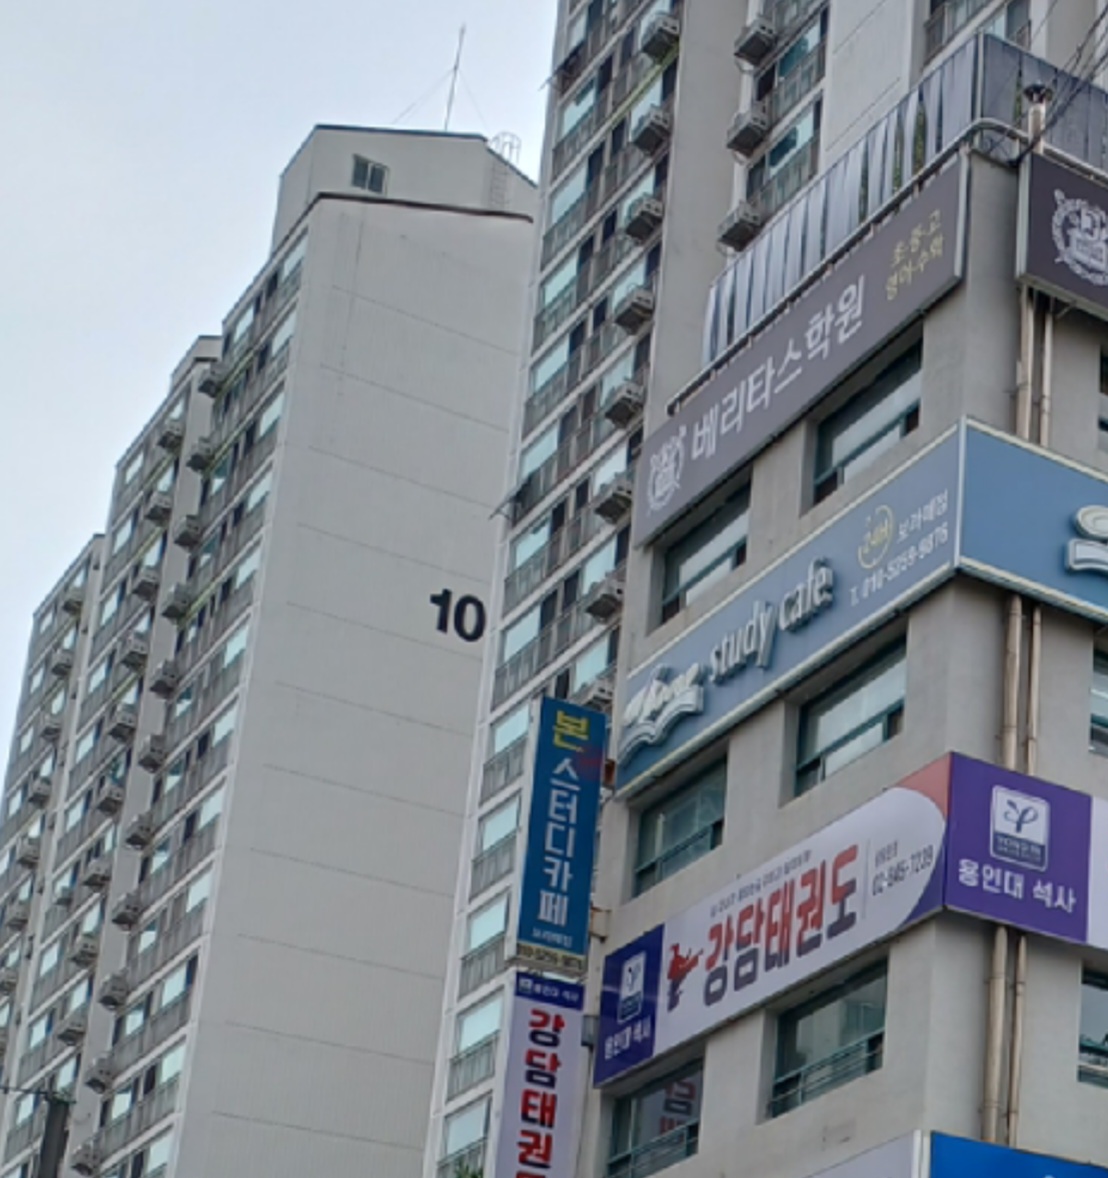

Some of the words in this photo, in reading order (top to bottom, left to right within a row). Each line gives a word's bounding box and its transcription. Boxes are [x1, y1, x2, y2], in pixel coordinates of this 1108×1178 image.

[691, 275, 864, 460] 베리타스학원
[430, 588, 486, 642] 10
[709, 600, 777, 684] study
[778, 556, 836, 632] cafe
[553, 710, 588, 752] 본
[537, 757, 580, 927] 스터디카페
[958, 858, 1023, 899] 용인대
[1032, 883, 1076, 913] 석사
[704, 845, 858, 1006] 강담태권도
